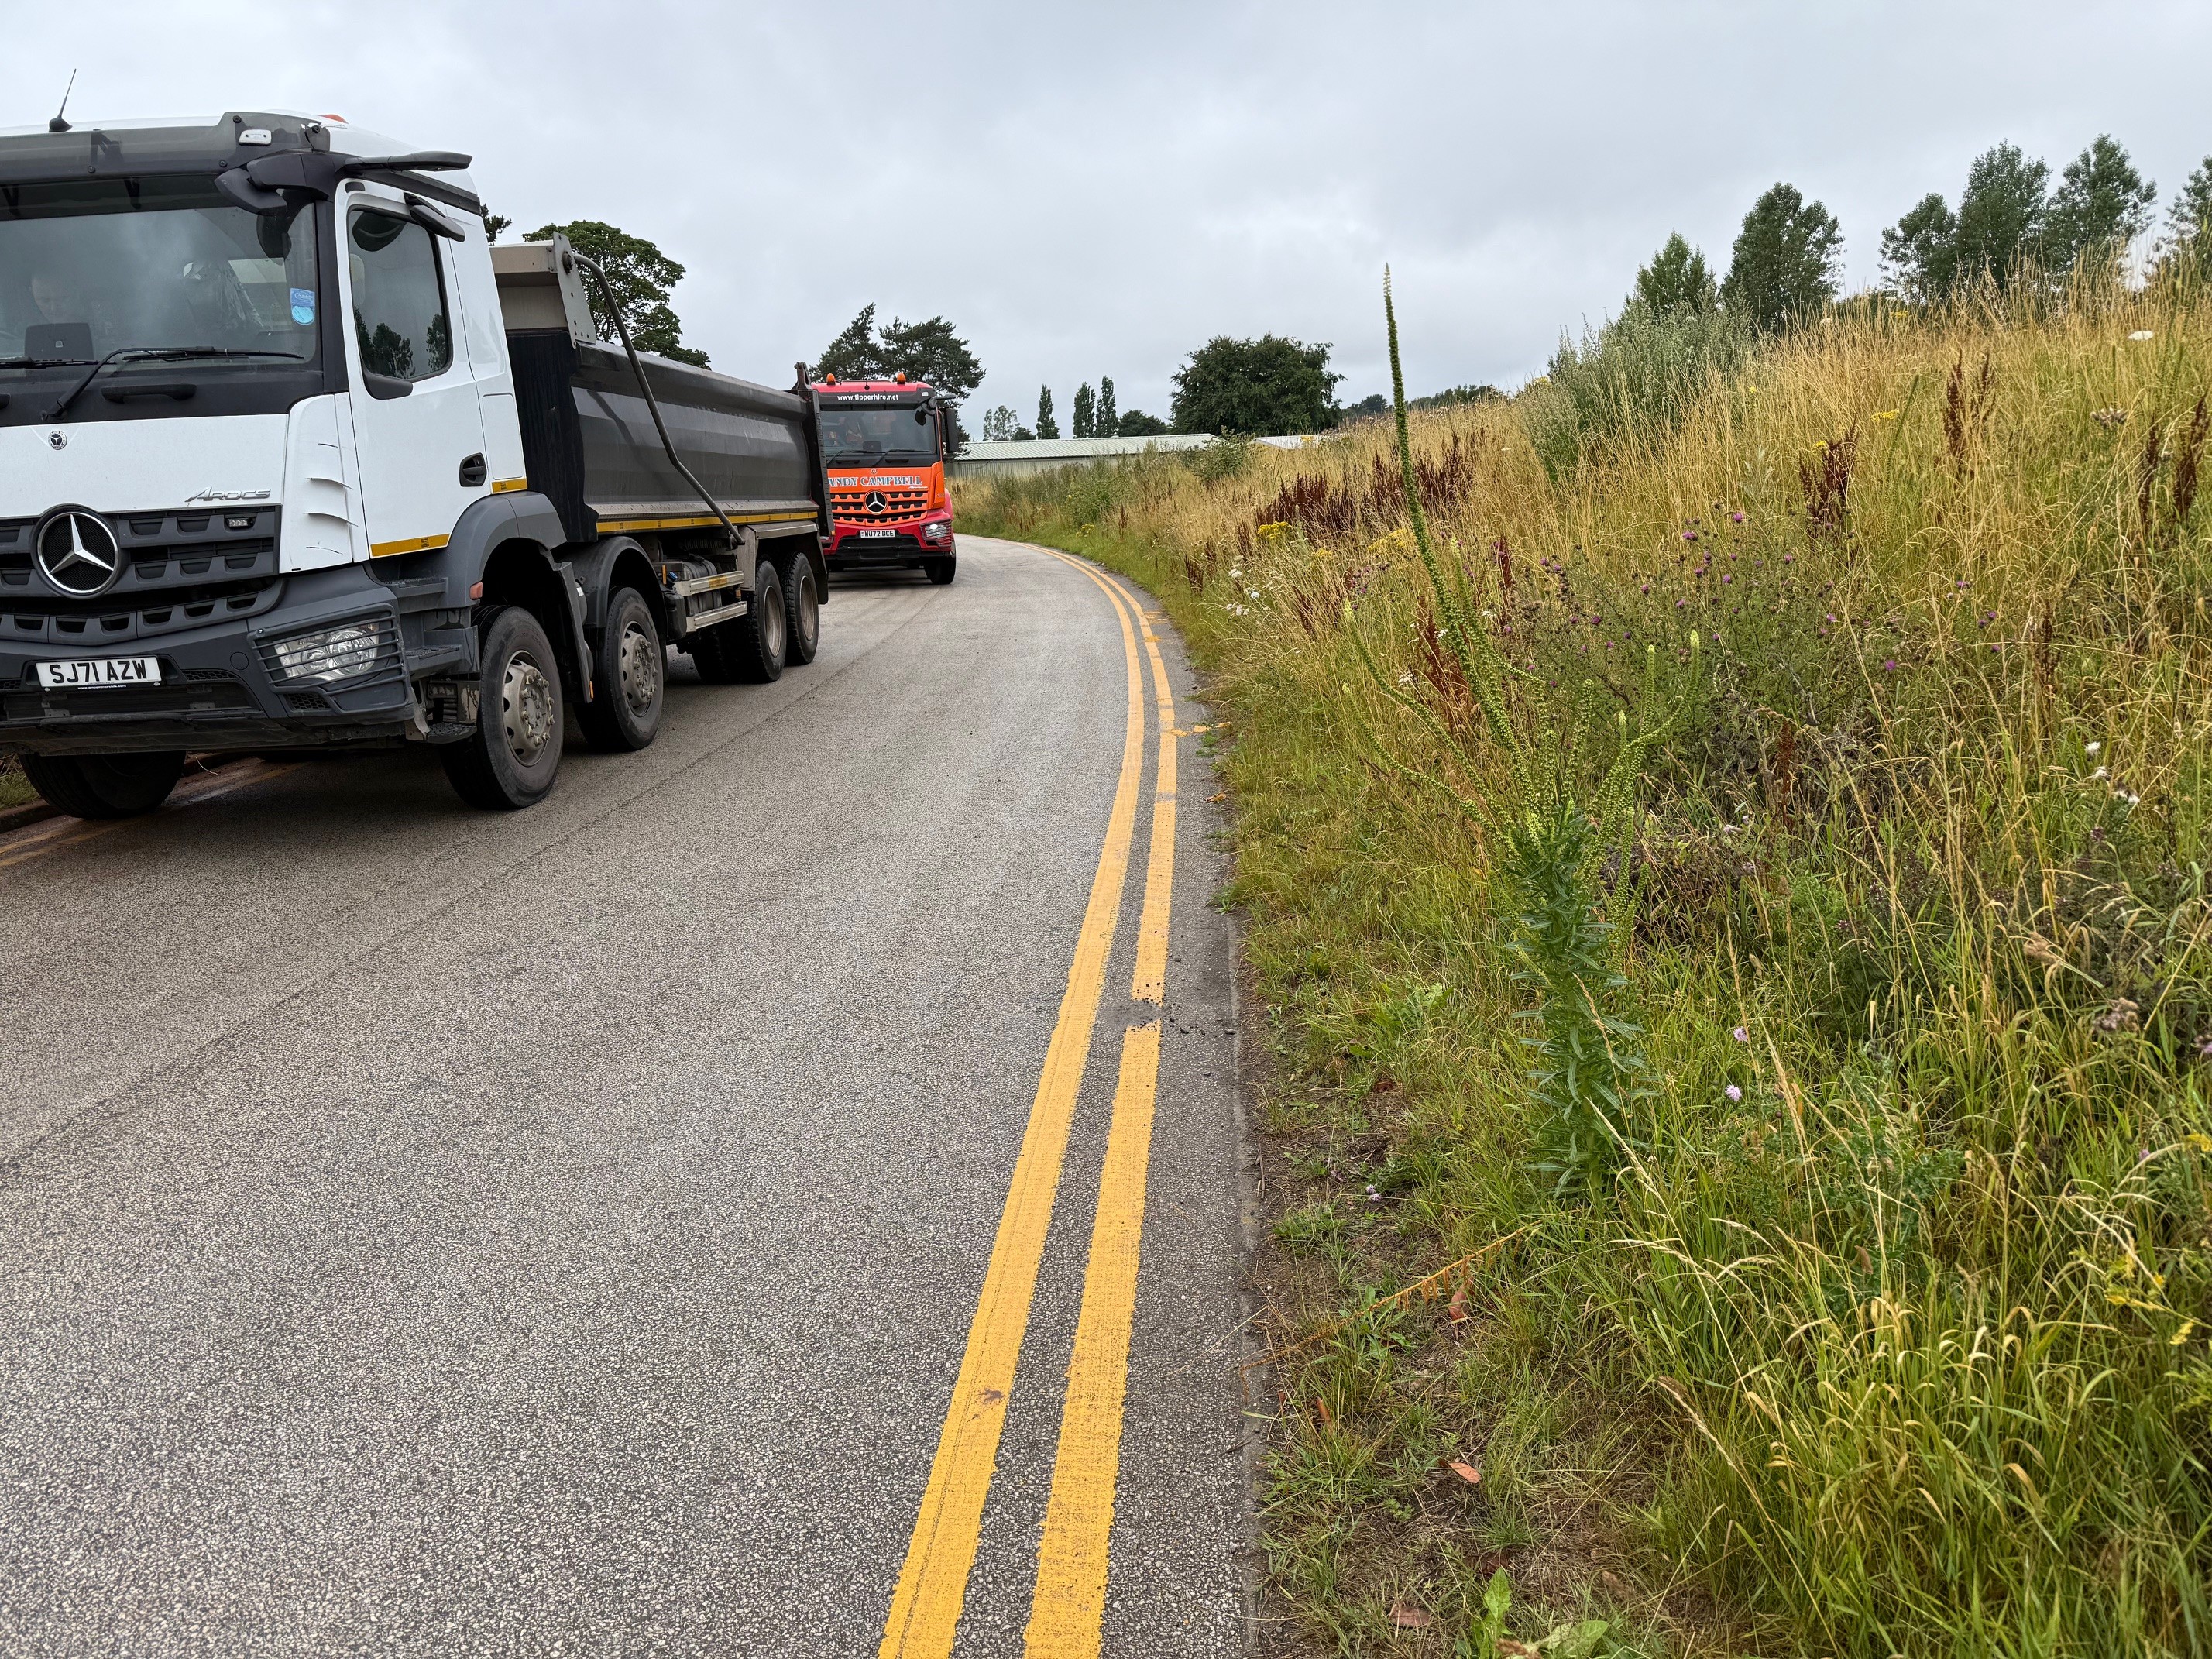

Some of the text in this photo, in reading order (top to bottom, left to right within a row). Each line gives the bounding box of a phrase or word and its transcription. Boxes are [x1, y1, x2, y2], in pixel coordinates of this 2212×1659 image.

[828, 476, 922, 487] ANDY CAMPBELL
[50, 659, 147, 684] SJ71 AZW
